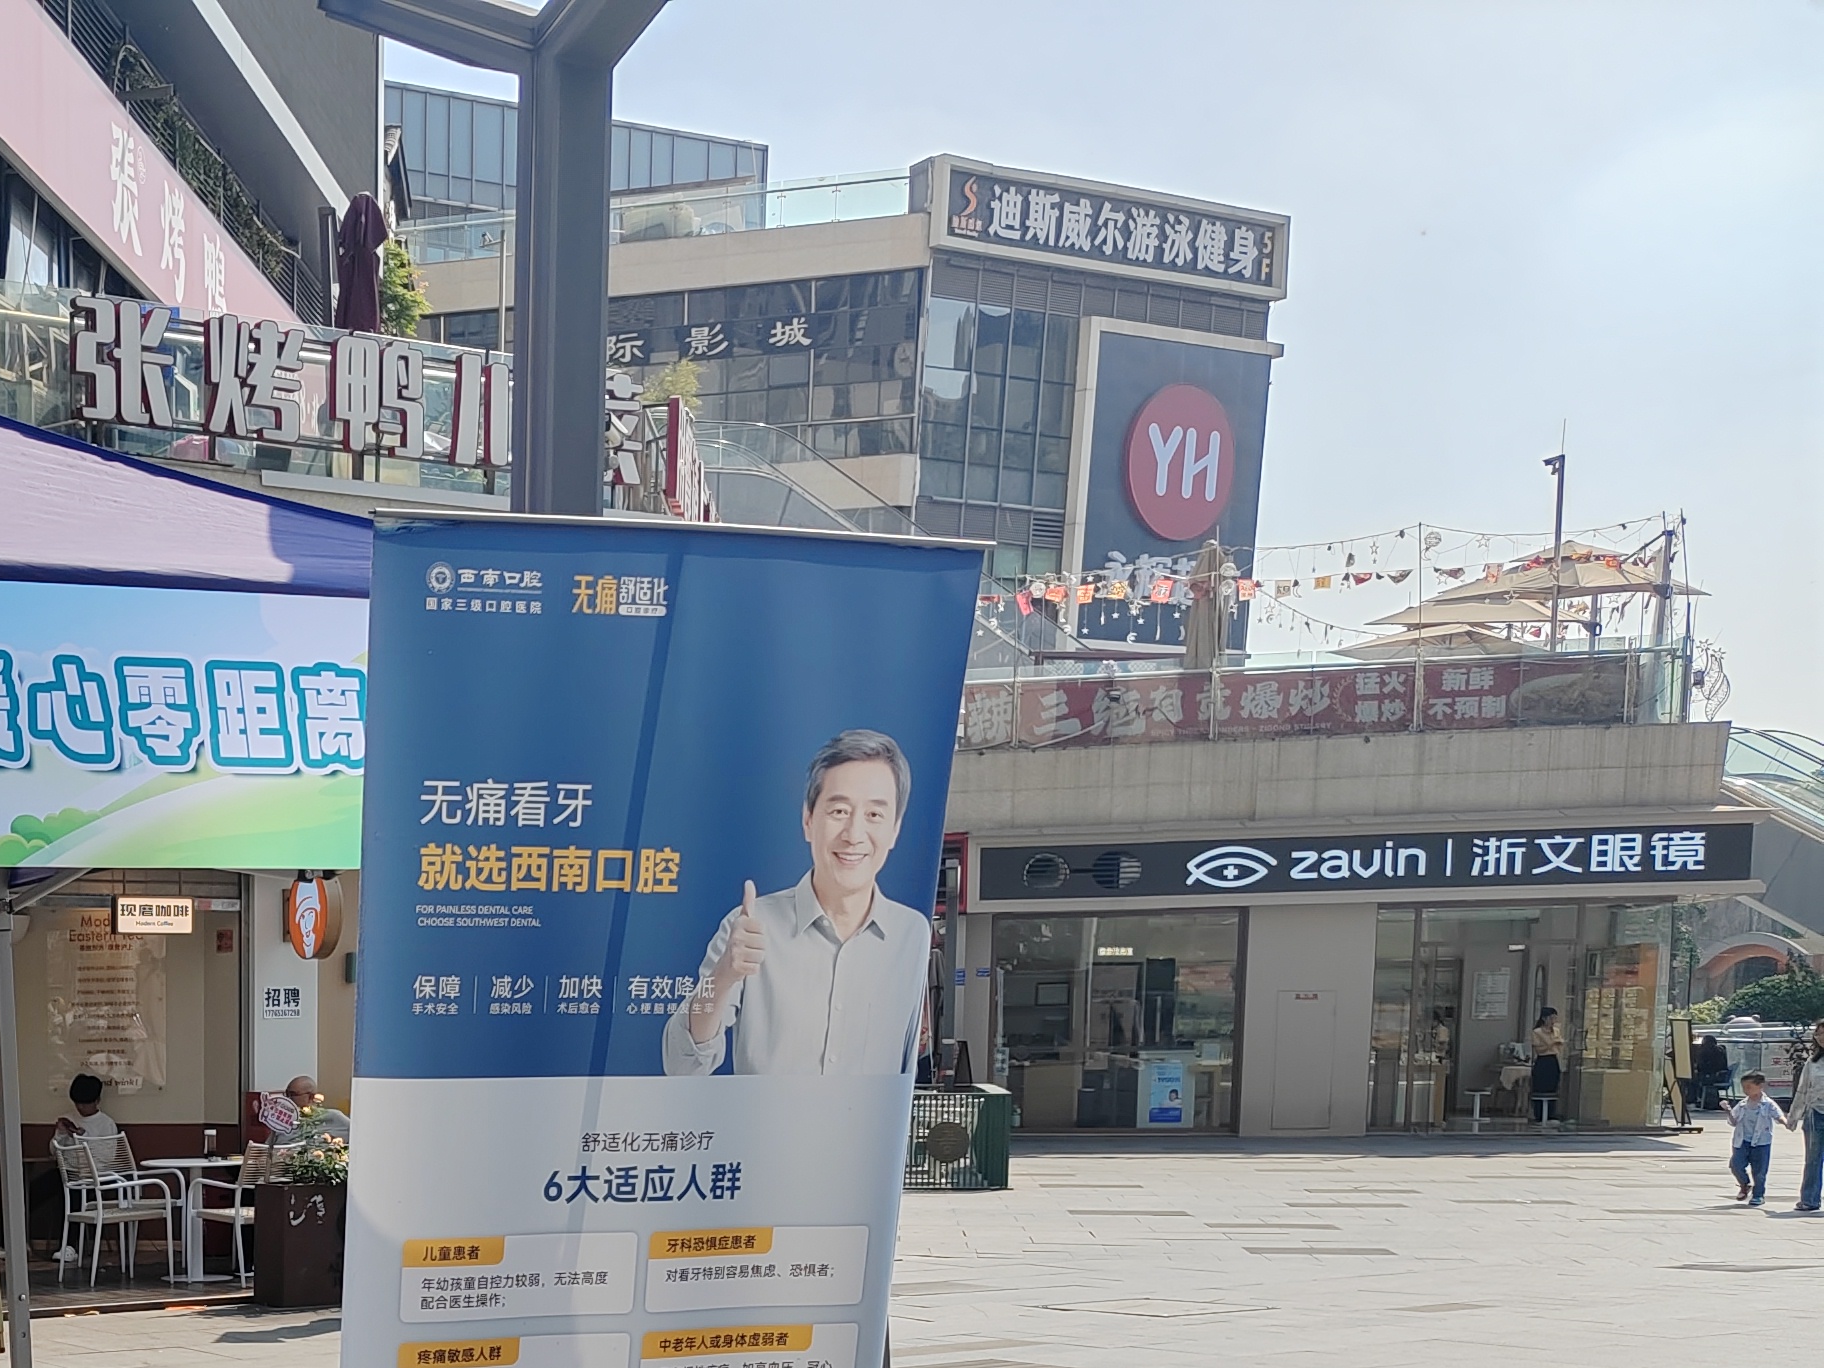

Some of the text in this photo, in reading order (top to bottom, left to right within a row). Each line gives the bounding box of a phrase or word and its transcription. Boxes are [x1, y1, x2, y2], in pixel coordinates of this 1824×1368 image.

[988, 183, 1259, 279] 迪斯威尔游泳健身
[606, 315, 814, 363] 际影城
[1148, 422, 1221, 502] YH
[457, 568, 543, 588] 西南口腔
[425, 597, 543, 616] 国家三级口腔医院
[571, 575, 669, 615] 无痛 舒适化
[1356, 670, 1407, 695] 猛火
[1441, 667, 1495, 691] 新鲜
[1428, 696, 1506, 721] 不预制
[419, 779, 594, 829] 无痛看牙
[1289, 838, 1428, 882] zavin
[1470, 830, 1706, 878] 浙文眼镜
[417, 843, 682, 895] 就选西南口腔
[120, 904, 190, 917] 现磨咖啡
[415, 905, 534, 915] FOR PAINLESS DENTAL CARE
[417, 917, 542, 927] CHOOSE SOUTHWEST DENTAL
[264, 987, 301, 1008] 招聘
[412, 975, 716, 1000] 保障 减少 加快 有效降低
[412, 1003, 459, 1015] 手术安全
[489, 1003, 532, 1015] 感染风险
[556, 1003, 601, 1015] 术后愈合
[580, 1131, 715, 1153] 舒适化无痛诊疗
[543, 1162, 743, 1203] 6大适应人群
[423, 1245, 481, 1262] 儿童患者
[666, 1235, 757, 1253] 牙科恐惧症患者
[417, 1346, 502, 1364] 疼痛敏感人群
[659, 1333, 789, 1353] 中老年人或身体虚弱者
